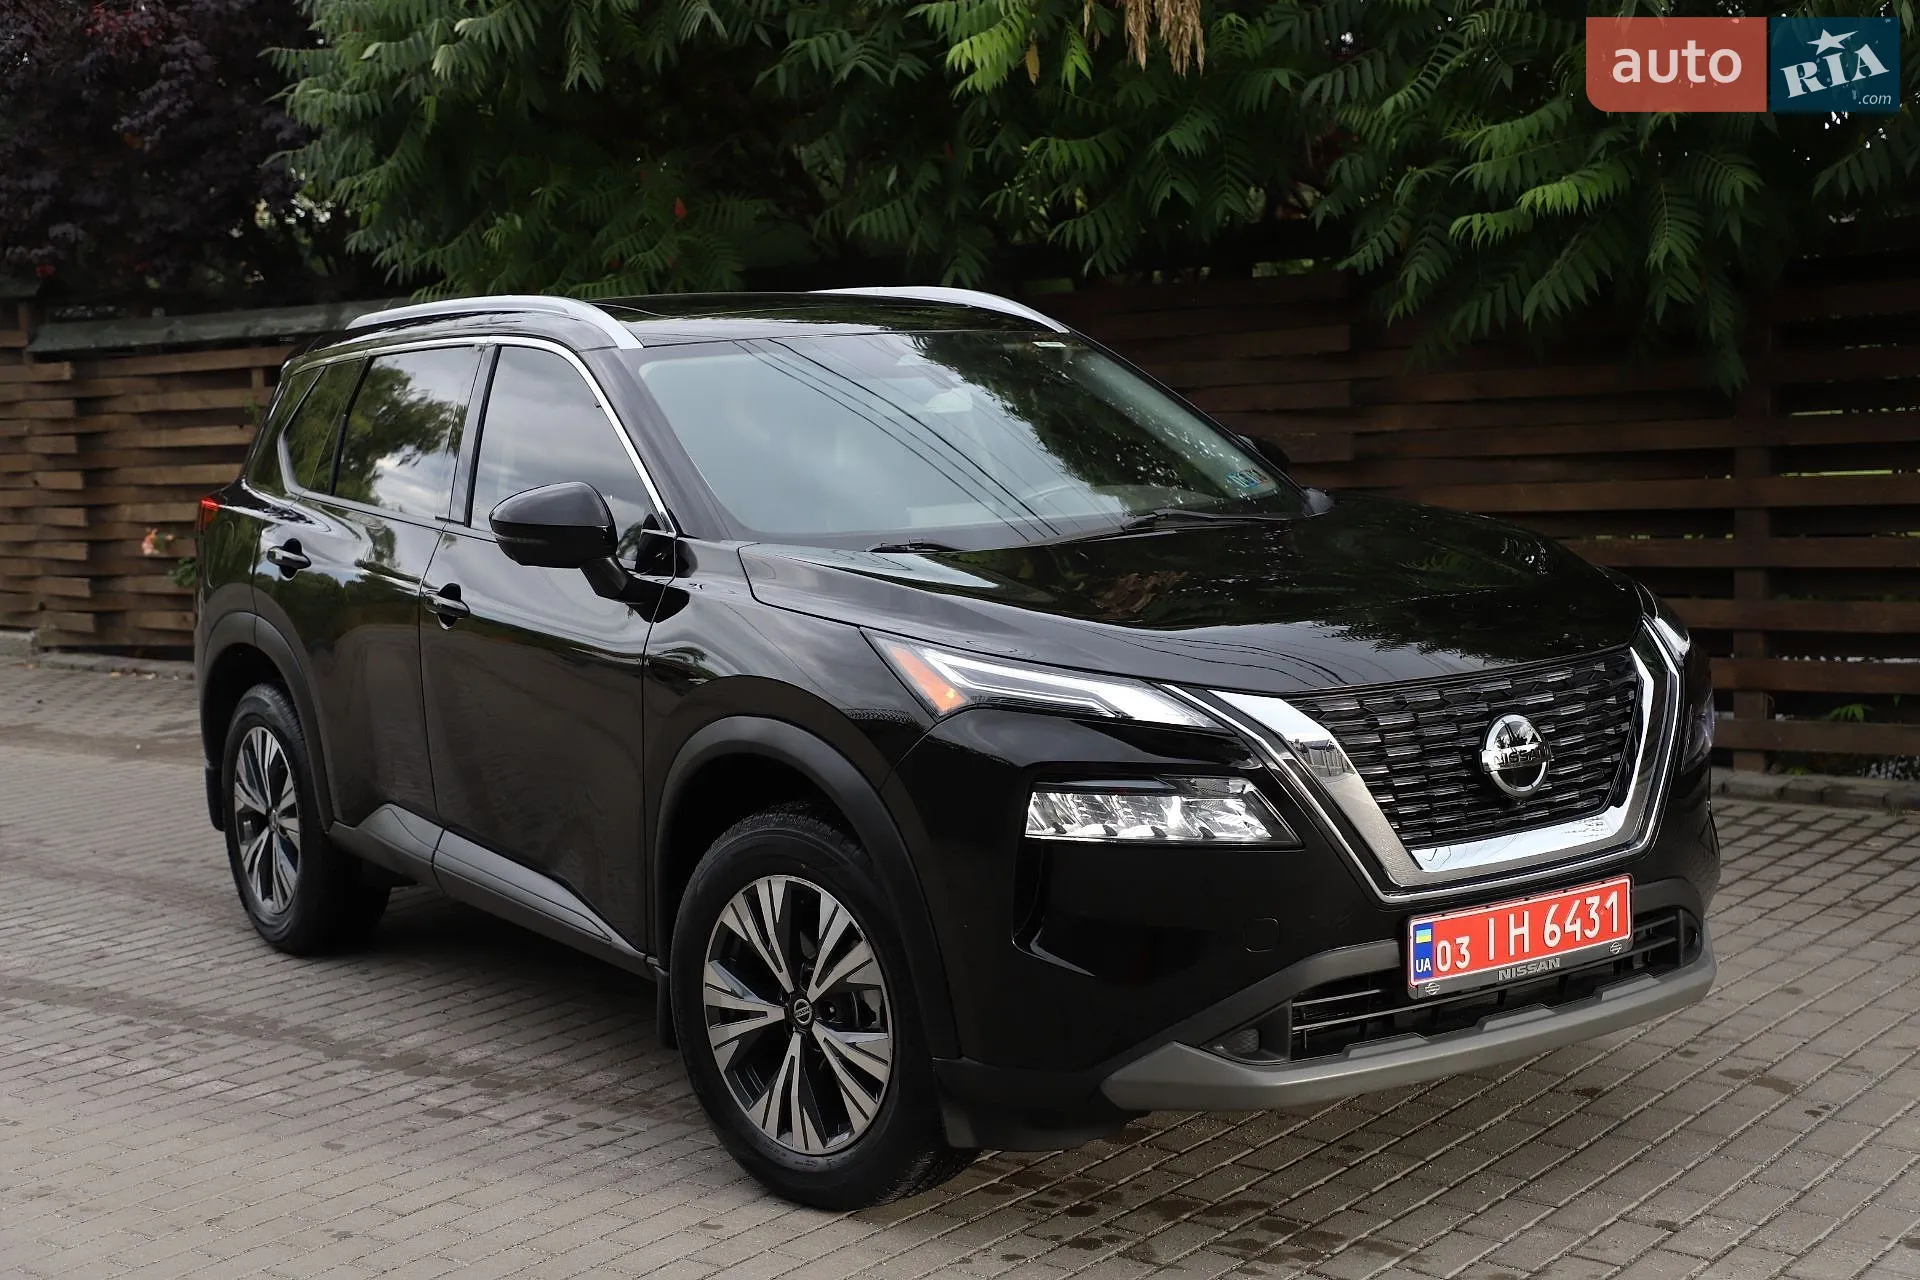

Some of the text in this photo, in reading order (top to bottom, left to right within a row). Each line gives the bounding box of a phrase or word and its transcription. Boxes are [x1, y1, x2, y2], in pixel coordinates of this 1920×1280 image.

[1436, 935, 1470, 972] 03
[1543, 890, 1619, 948] 6431
[1415, 957, 1432, 973] UA
[1498, 957, 1560, 981] NISSAN
